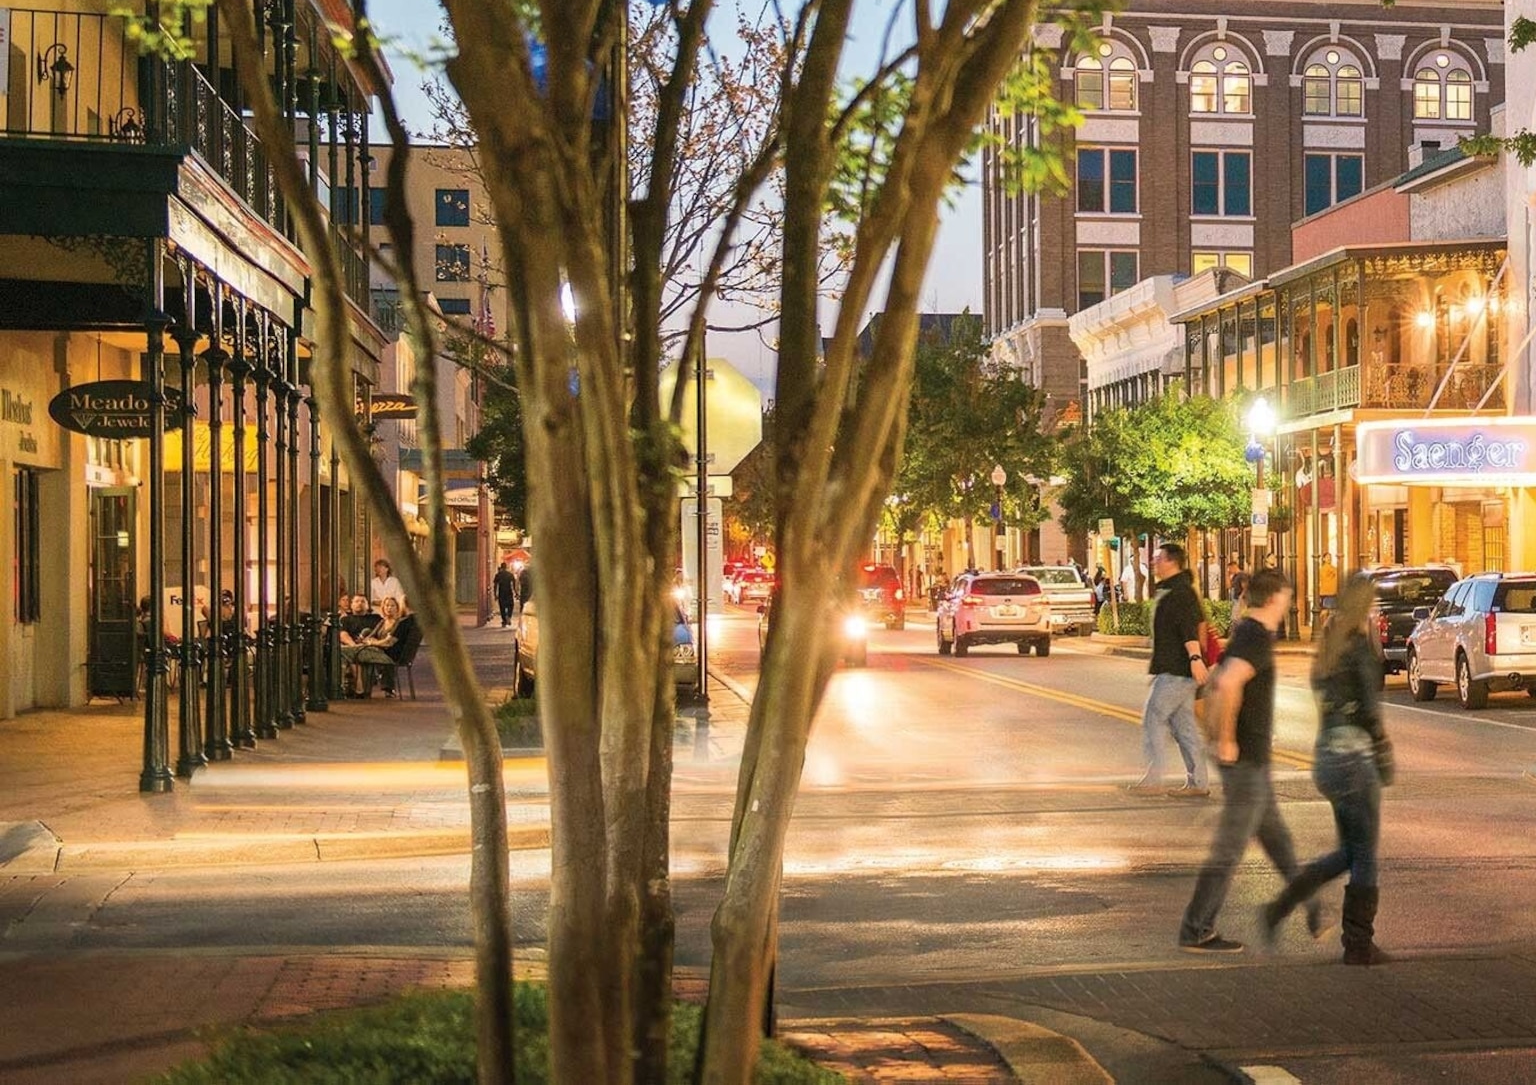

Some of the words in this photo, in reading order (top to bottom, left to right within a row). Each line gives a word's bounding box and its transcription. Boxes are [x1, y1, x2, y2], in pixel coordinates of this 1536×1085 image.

[69, 393, 182, 411] Meados'
[97, 415, 170, 428] Jeweles
[1394, 430, 1525, 474] Saenger
[170, 595, 204, 606] Fex
